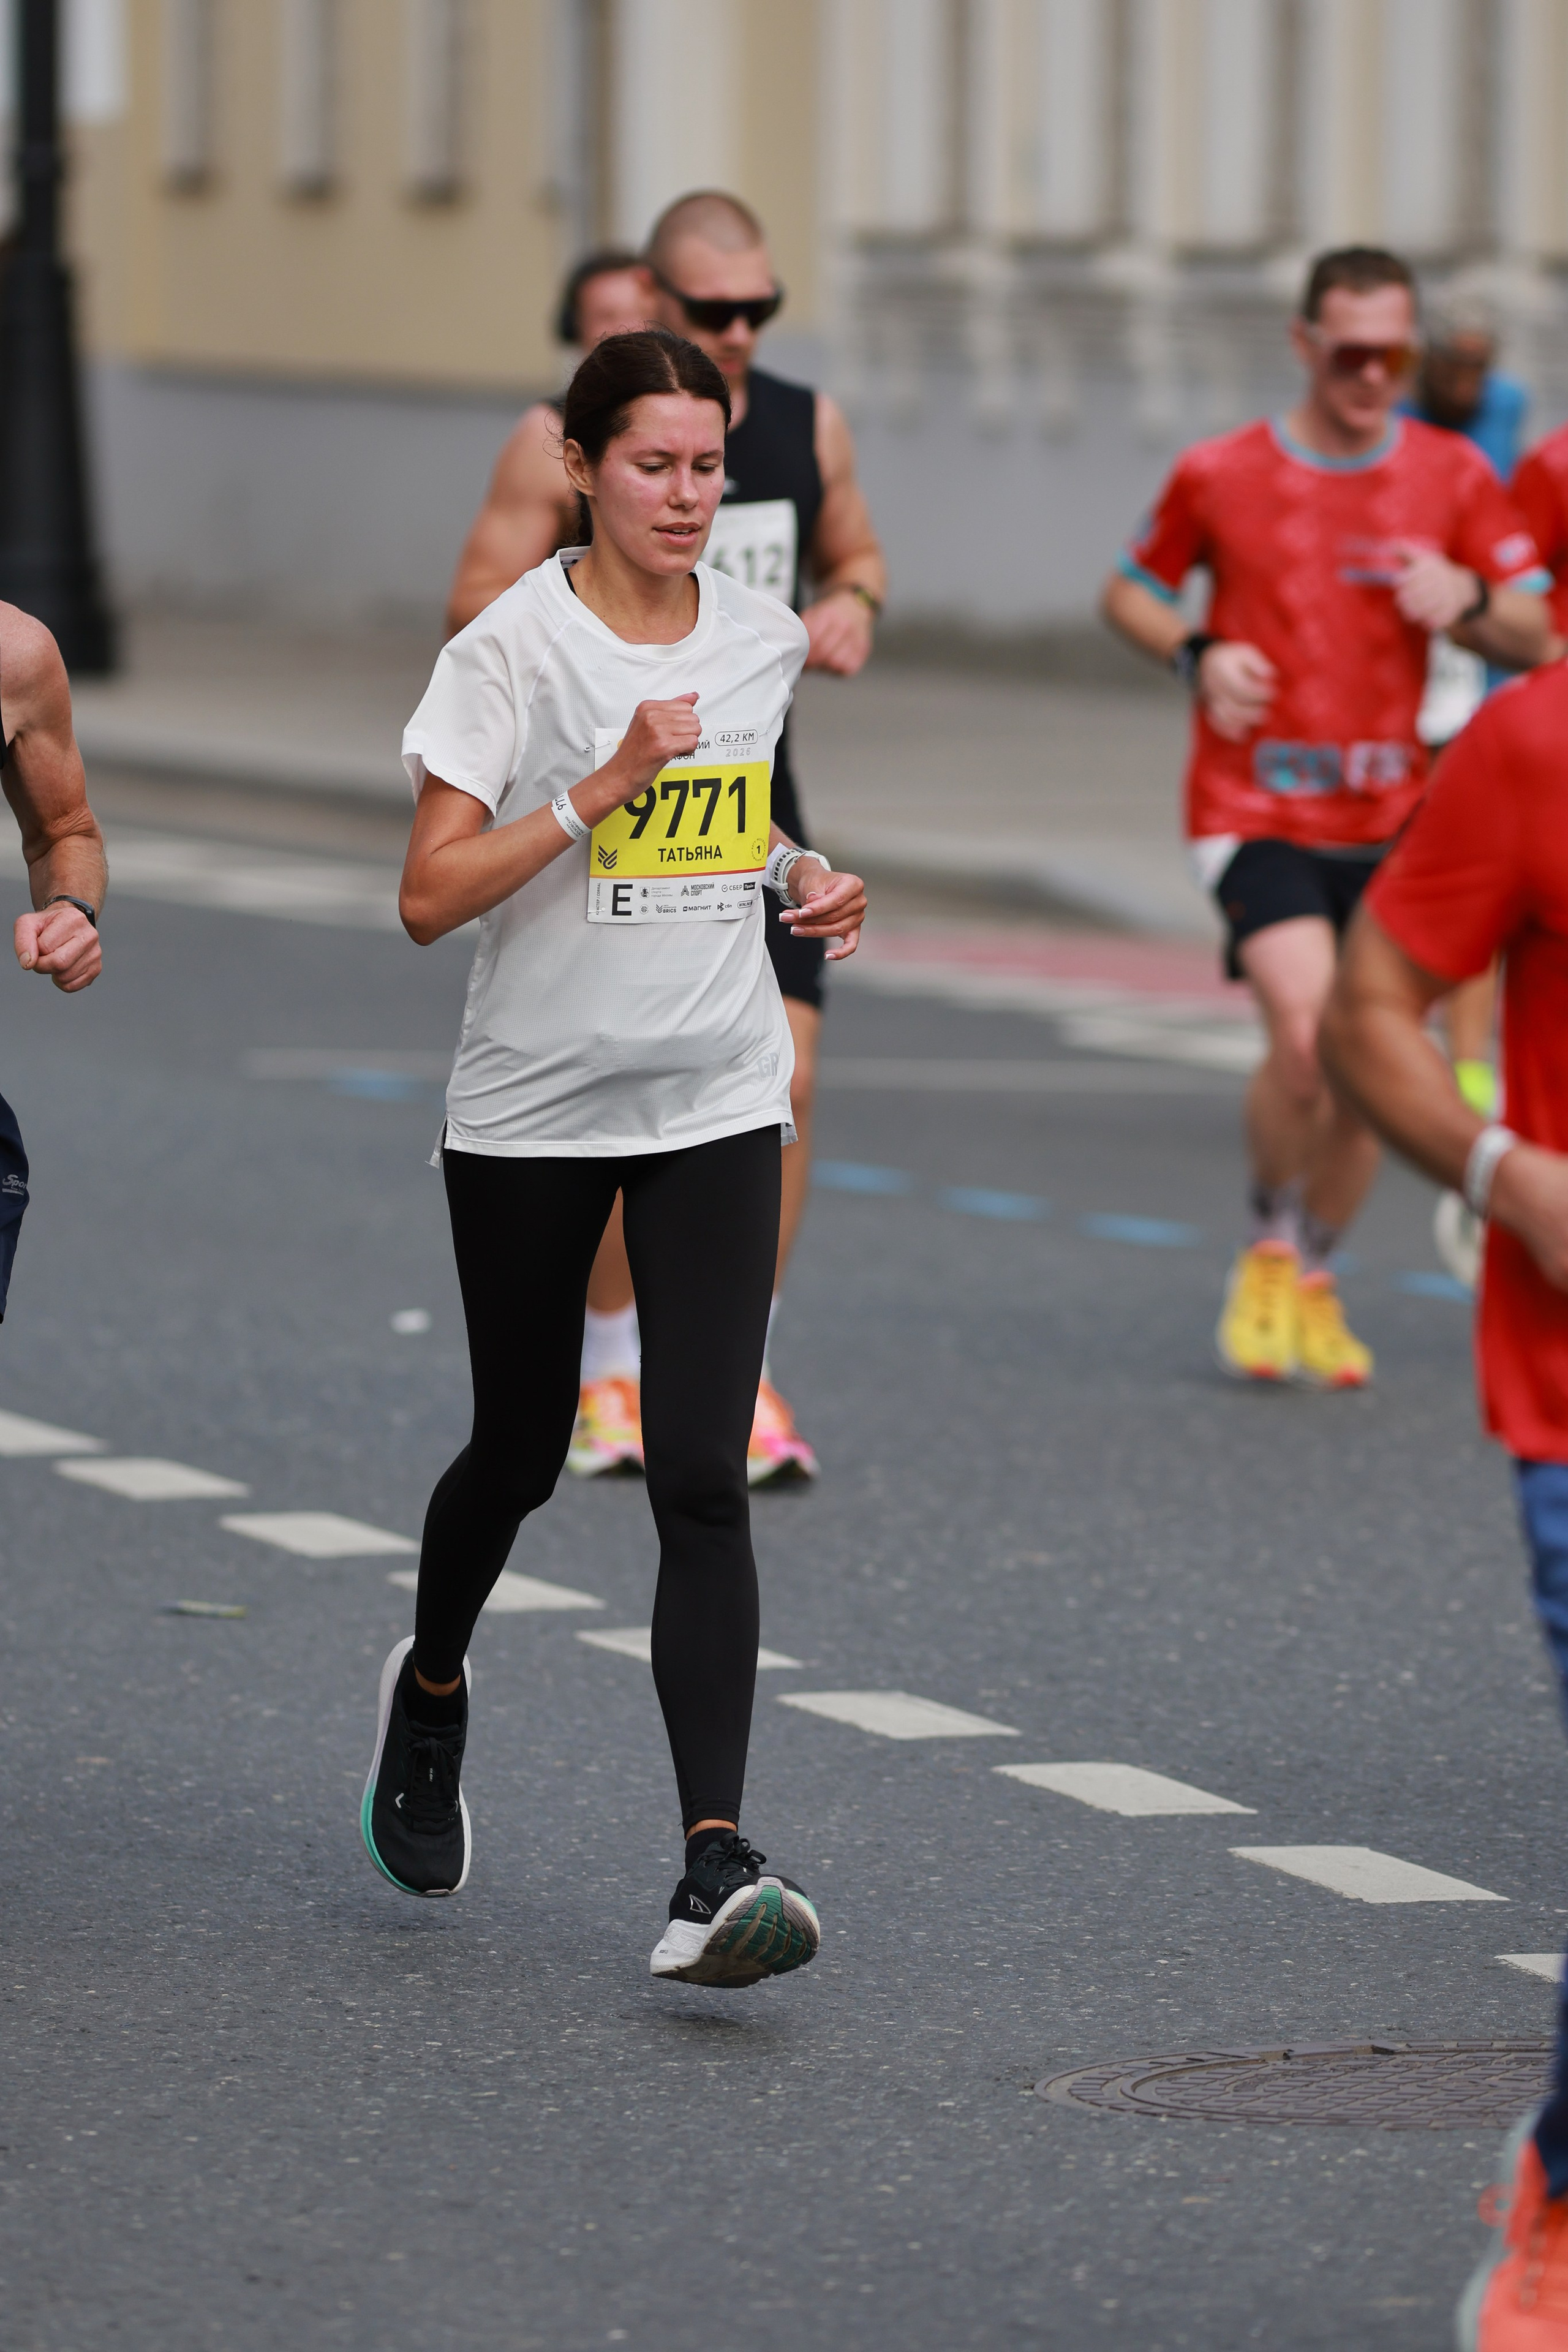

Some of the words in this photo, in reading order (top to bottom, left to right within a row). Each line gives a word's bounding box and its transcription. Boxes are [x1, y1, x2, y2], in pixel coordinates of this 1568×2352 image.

[720, 733, 739, 744] 42,2
[624, 775, 747, 839] 9771
[658, 844, 723, 862] ТАТЬЯНА
[756, 845, 761, 854] 1
[611, 884, 633, 916] E
